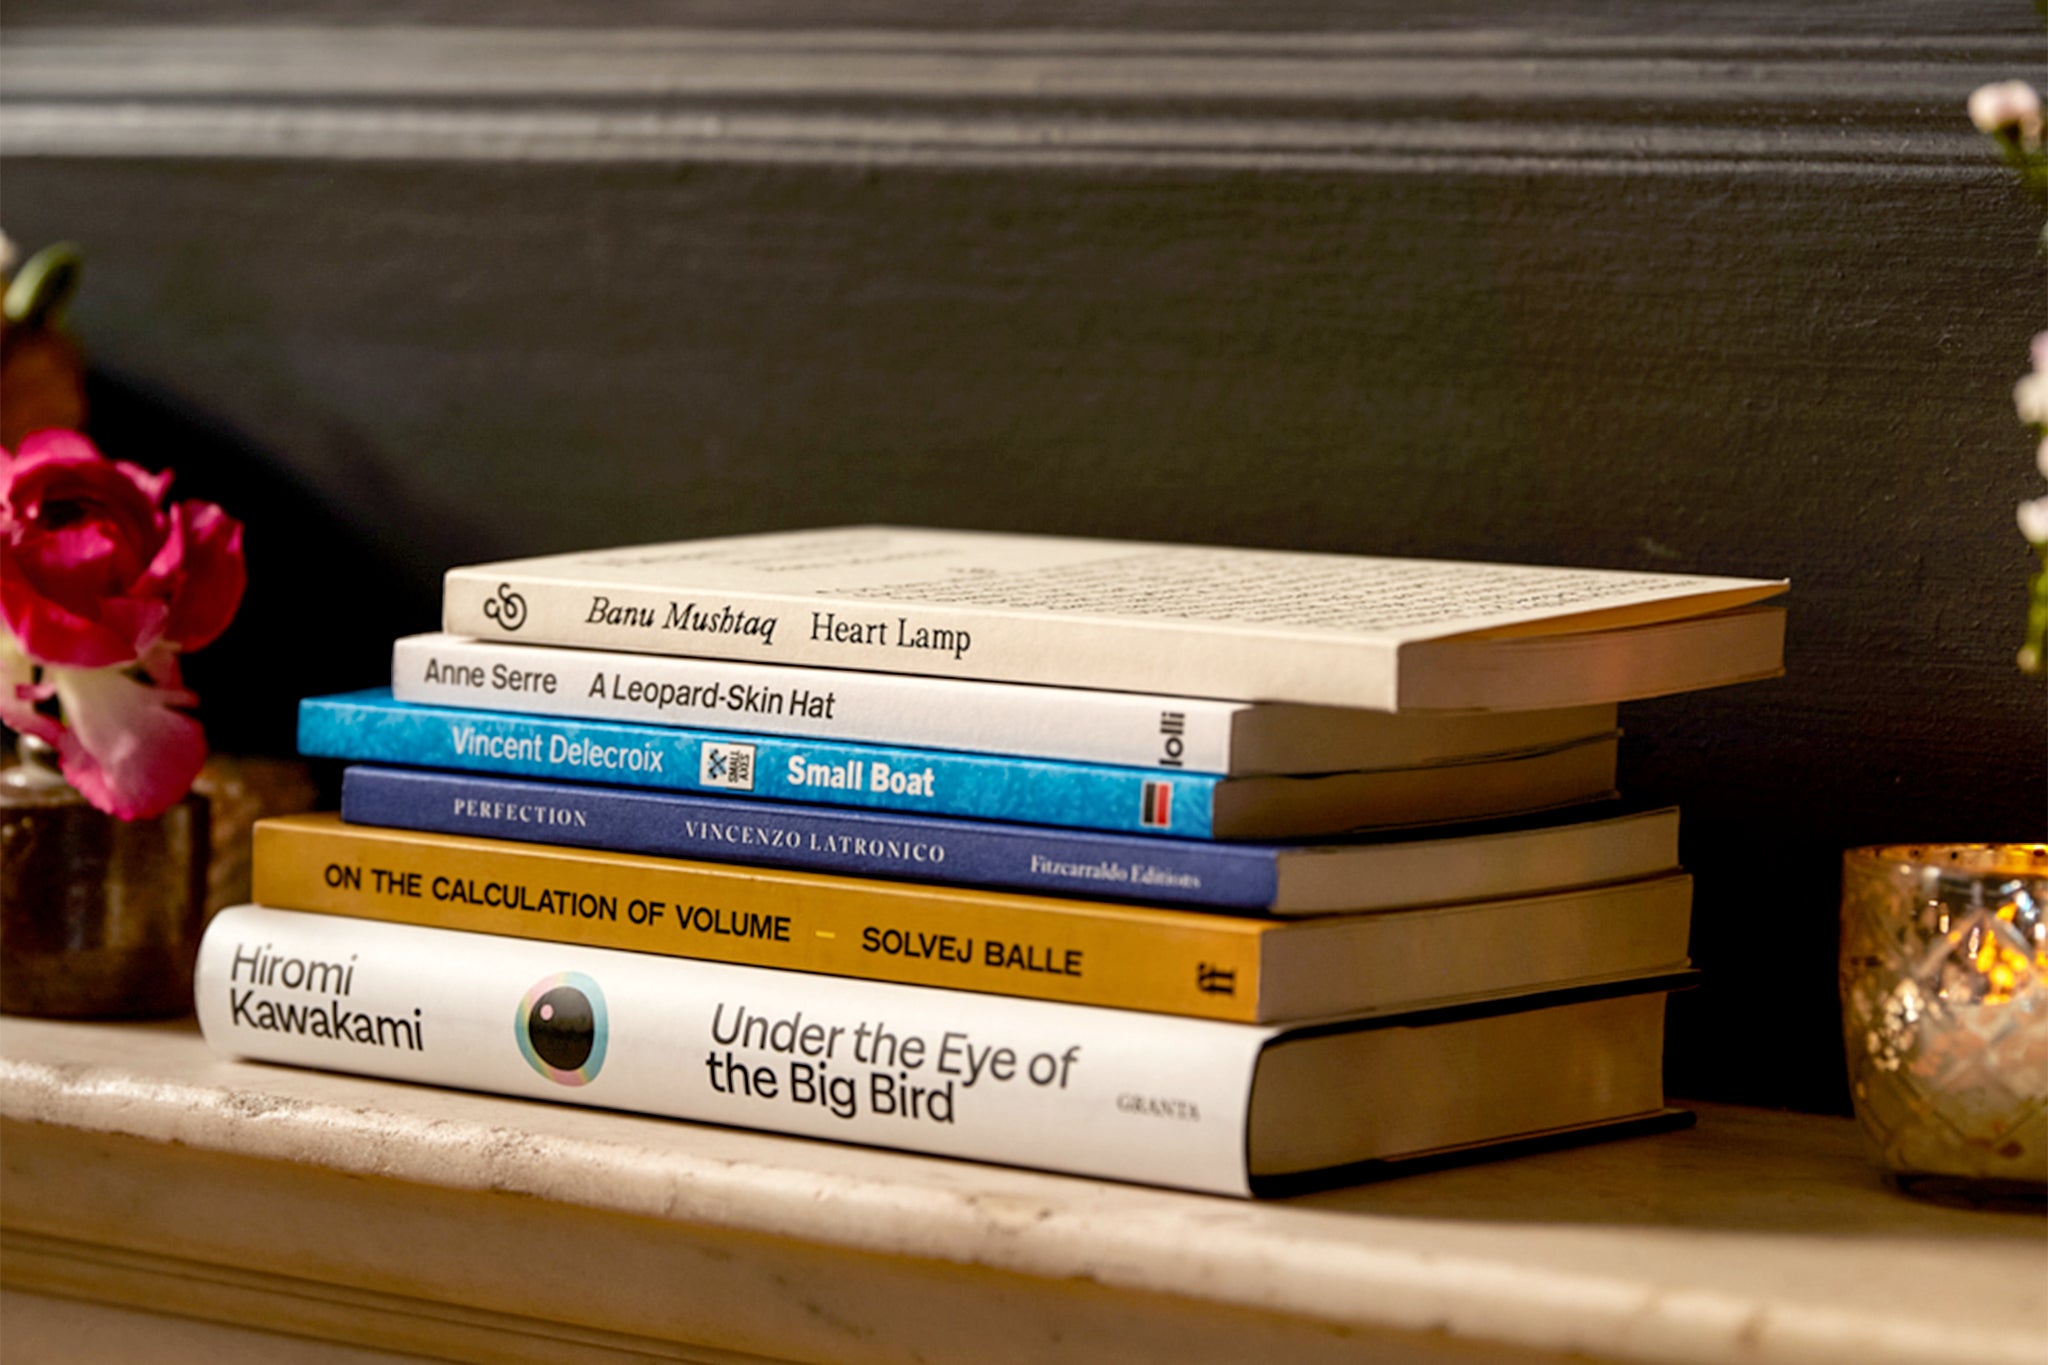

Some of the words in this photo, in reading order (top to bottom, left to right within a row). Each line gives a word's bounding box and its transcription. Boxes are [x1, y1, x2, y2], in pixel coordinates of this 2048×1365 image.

[585, 596, 655, 628] Banu
[661, 601, 778, 645] Mushtaq
[811, 612, 888, 645] Heart
[897, 617, 972, 660] Lamp
[424, 658, 485, 687] Anne
[491, 663, 557, 693] Serre
[588, 672, 606, 698] A
[612, 674, 783, 714] Leopard-Skin
[789, 689, 836, 719] Hat
[452, 725, 543, 762] Vincent
[550, 734, 664, 773] Delecroix
[1159, 711, 1186, 767] lolli
[729, 750, 740, 783] SMALL
[740, 754, 750, 781] AXES
[787, 755, 863, 790] Small
[870, 762, 935, 797] Boat
[453, 799, 588, 828] PERFECTION
[684, 820, 801, 849] VINCENZO
[810, 836, 946, 864] LATRONICO
[1030, 854, 1128, 882] Fitzcarraldo
[1130, 865, 1201, 889] Editions
[324, 863, 361, 890] ON
[370, 869, 422, 898] THE
[432, 876, 617, 921] CALCULATION
[628, 899, 665, 926] OF
[676, 905, 791, 942] VOLUME
[231, 943, 358, 996] Hiromi
[862, 926, 973, 964] SOLVEJ
[984, 940, 1083, 977] BALLE
[230, 987, 424, 1051] Kawakami
[711, 1003, 845, 1059] Under
[854, 1021, 926, 1070] the
[936, 1032, 1017, 1088] Eye
[1028, 1045, 1082, 1089] of
[705, 1051, 779, 1099] the
[790, 1062, 857, 1119] Big
[870, 1072, 955, 1125] Bird
[1116, 1093, 1201, 1122] GRANTA
